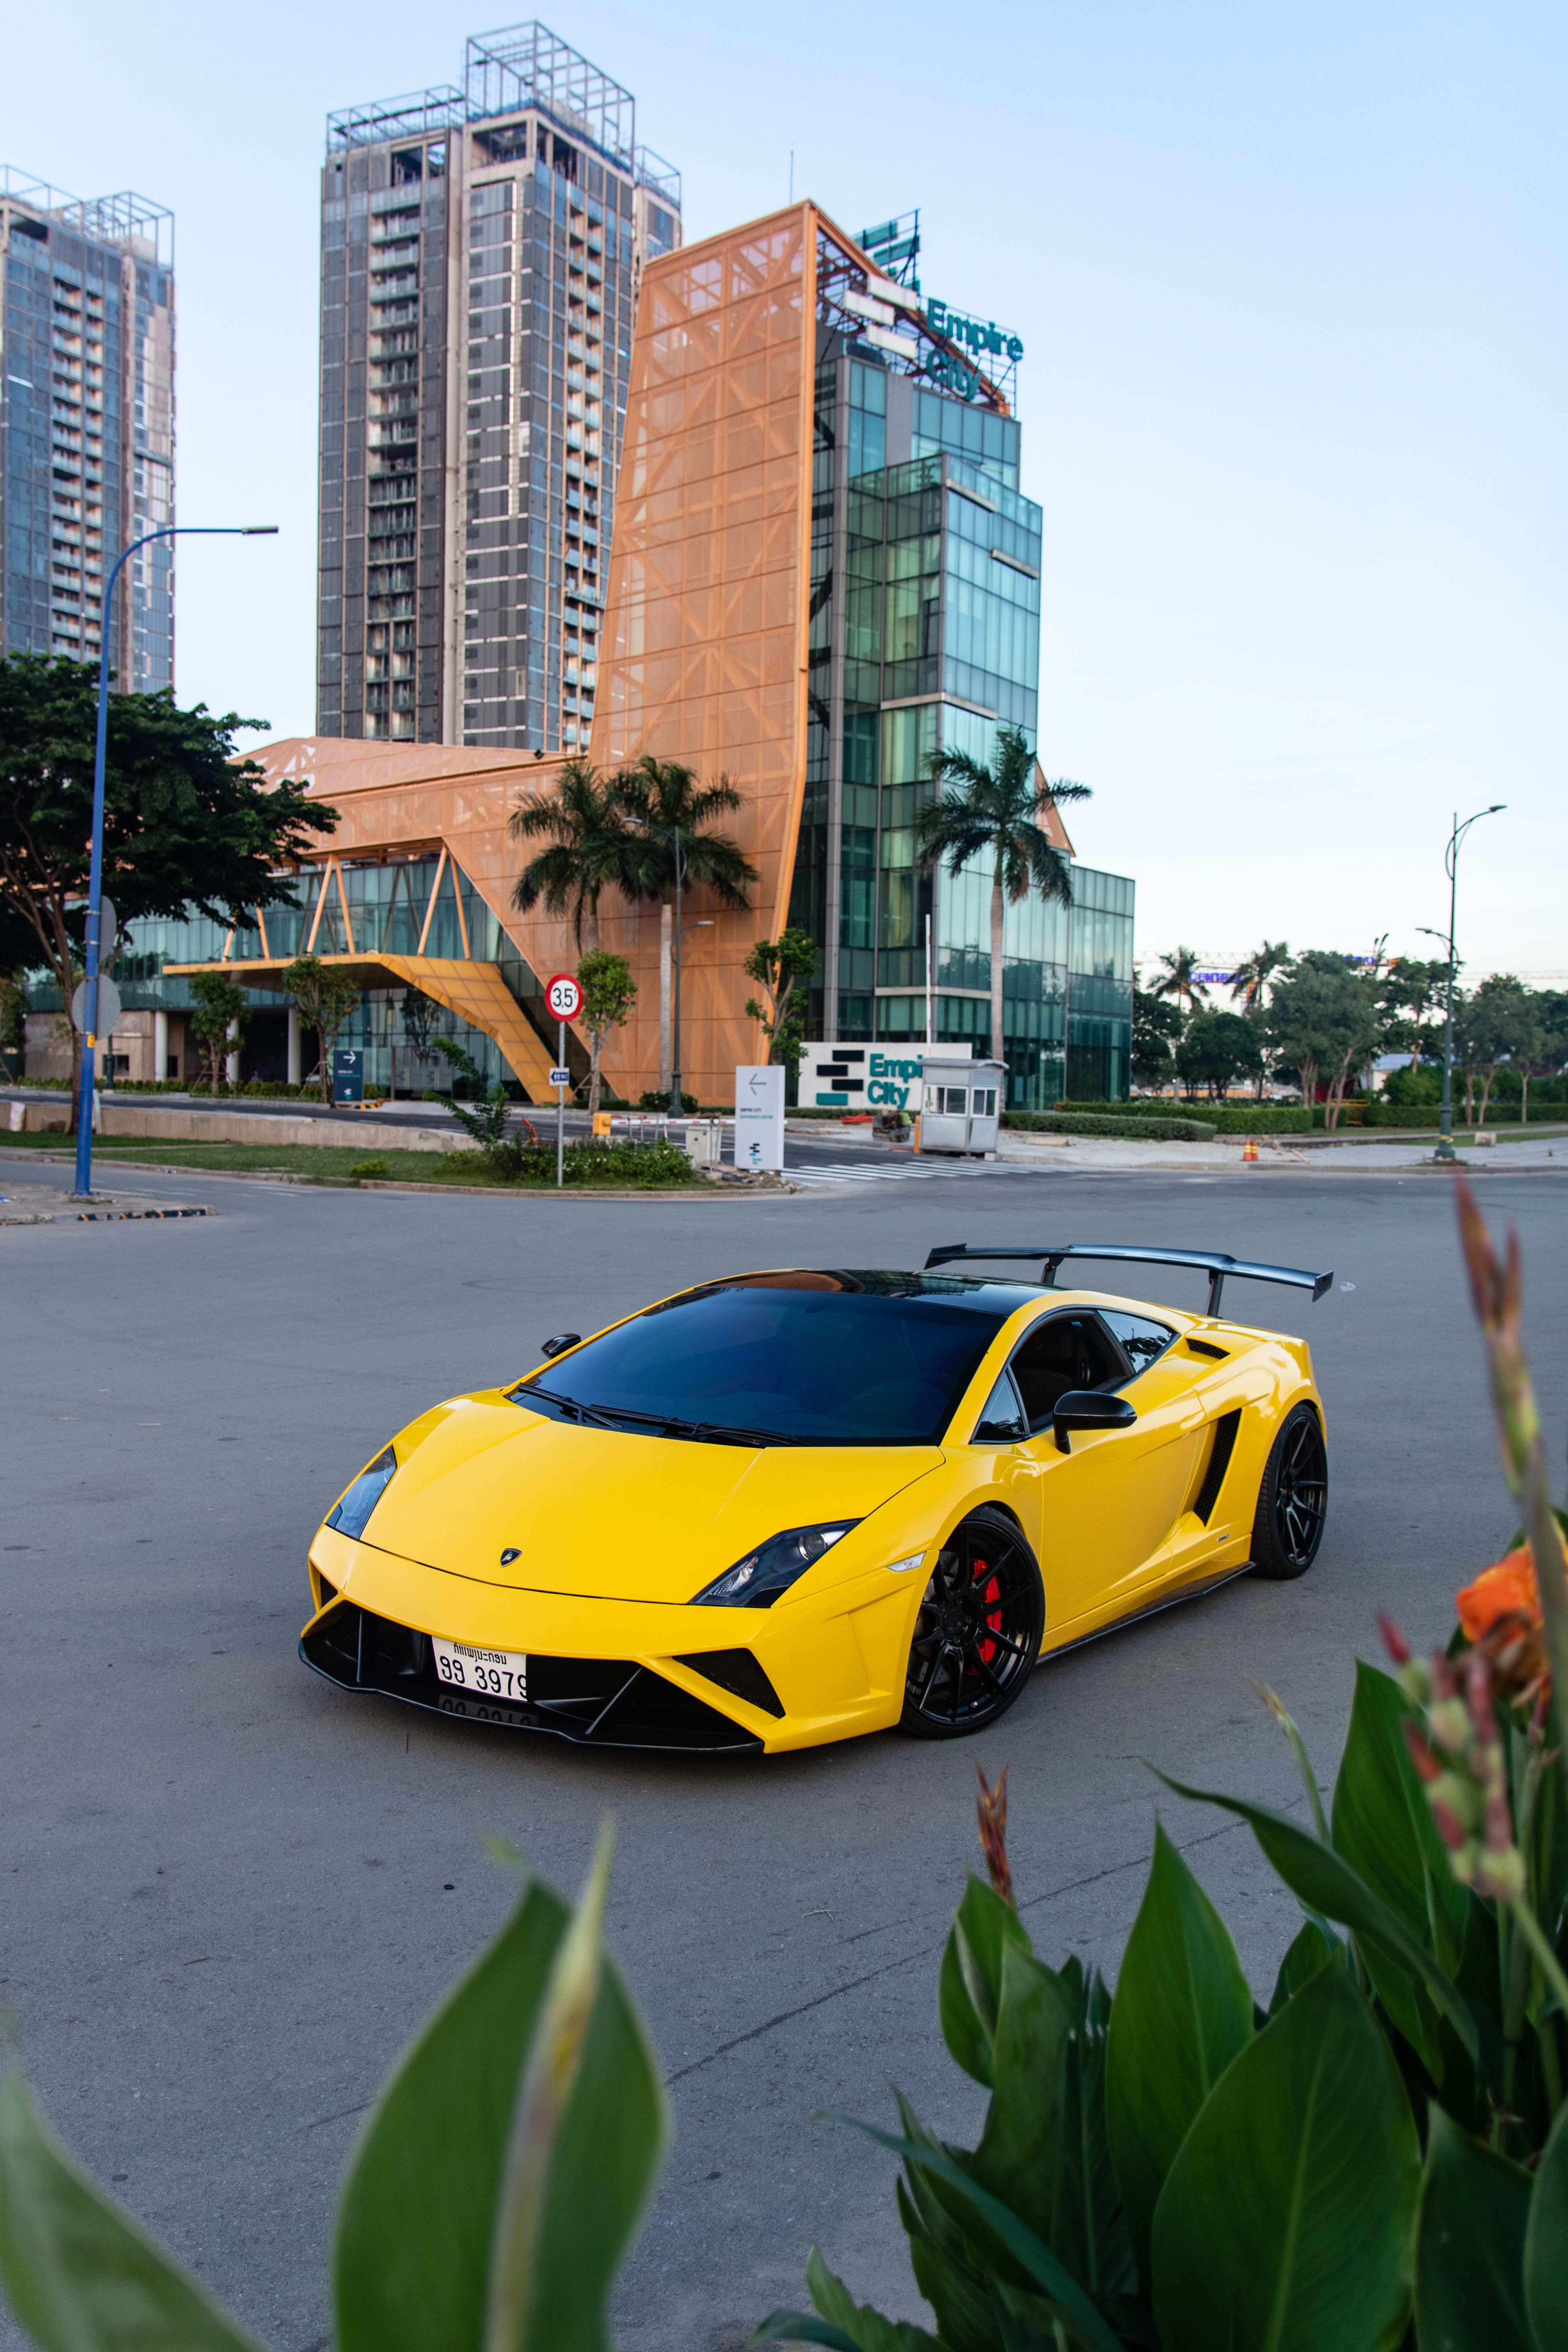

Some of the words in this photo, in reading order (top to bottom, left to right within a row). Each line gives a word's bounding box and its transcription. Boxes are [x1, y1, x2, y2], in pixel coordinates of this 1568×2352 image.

[927, 297, 1023, 361] Empire
[926, 348, 981, 401] City
[870, 1053, 923, 1083] Empi
[868, 1080, 910, 1109] City
[440, 1655, 465, 1684] 99
[475, 1666, 526, 1699] 3979
